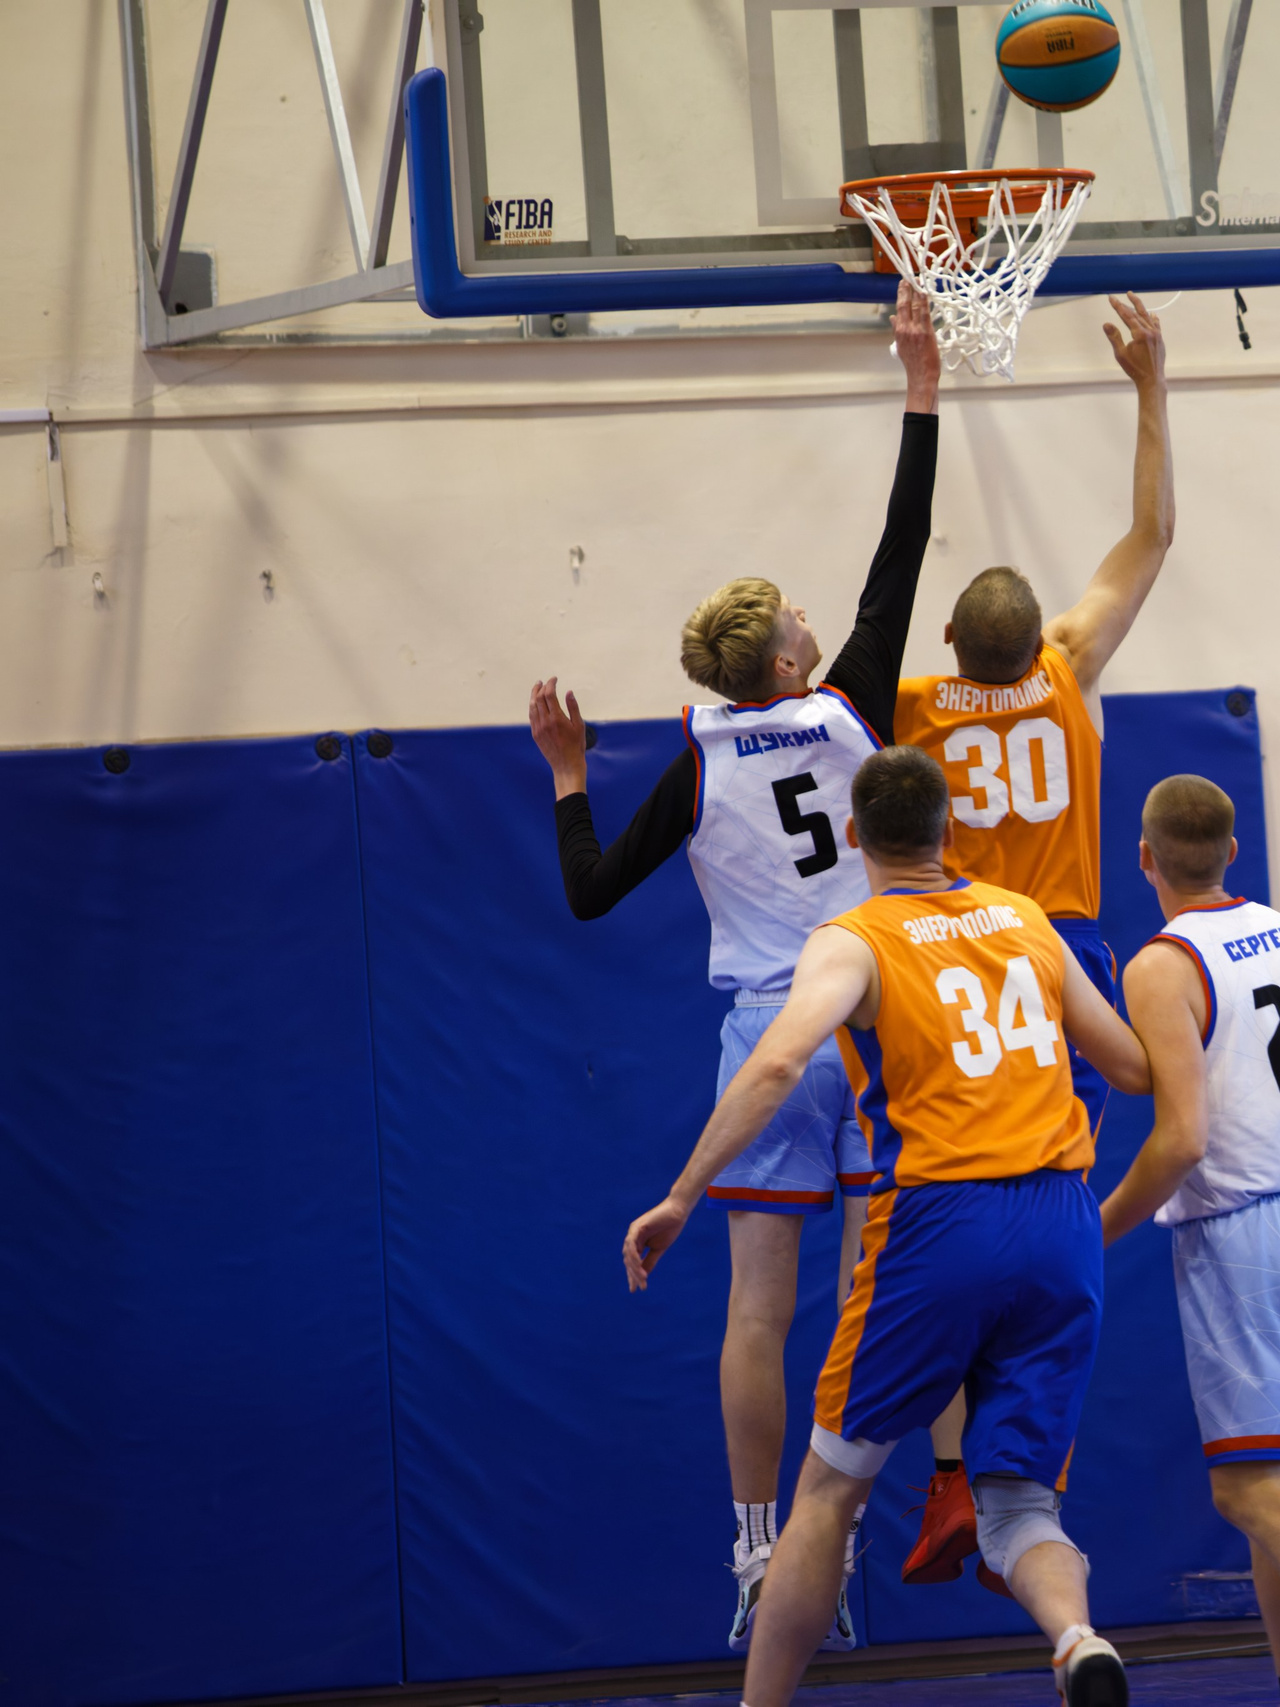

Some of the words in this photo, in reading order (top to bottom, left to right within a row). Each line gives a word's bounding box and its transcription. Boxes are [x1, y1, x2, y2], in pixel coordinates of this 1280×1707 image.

[504, 198, 553, 230] FIBA
[935, 669, 1053, 714] ЭНЕРГОПОЛИС
[734, 723, 831, 758] ЩУКИН
[943, 716, 1071, 829] 30
[771, 771, 839, 879] 5
[935, 954, 1060, 1079] 34
